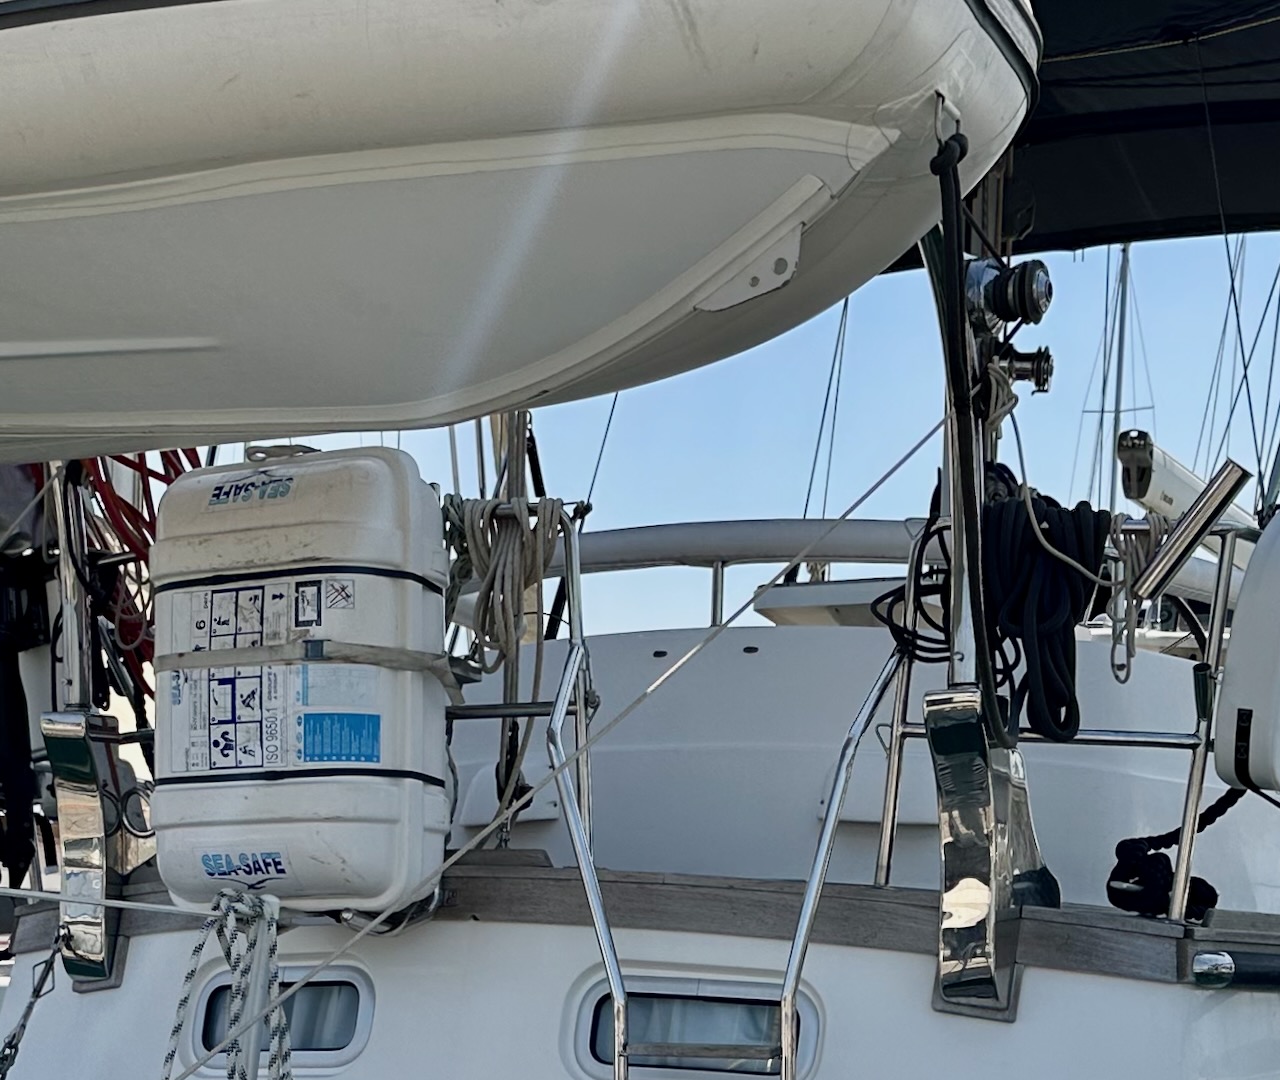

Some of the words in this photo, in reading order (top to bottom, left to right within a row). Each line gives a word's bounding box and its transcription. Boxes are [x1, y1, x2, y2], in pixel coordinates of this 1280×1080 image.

[208, 478, 294, 505] SEA-SAFE
[195, 619, 206, 631] 6
[171, 670, 182, 705] SEA-SA
[266, 744, 279, 764] ISO
[201, 852, 287, 877] SEA-SAFE
